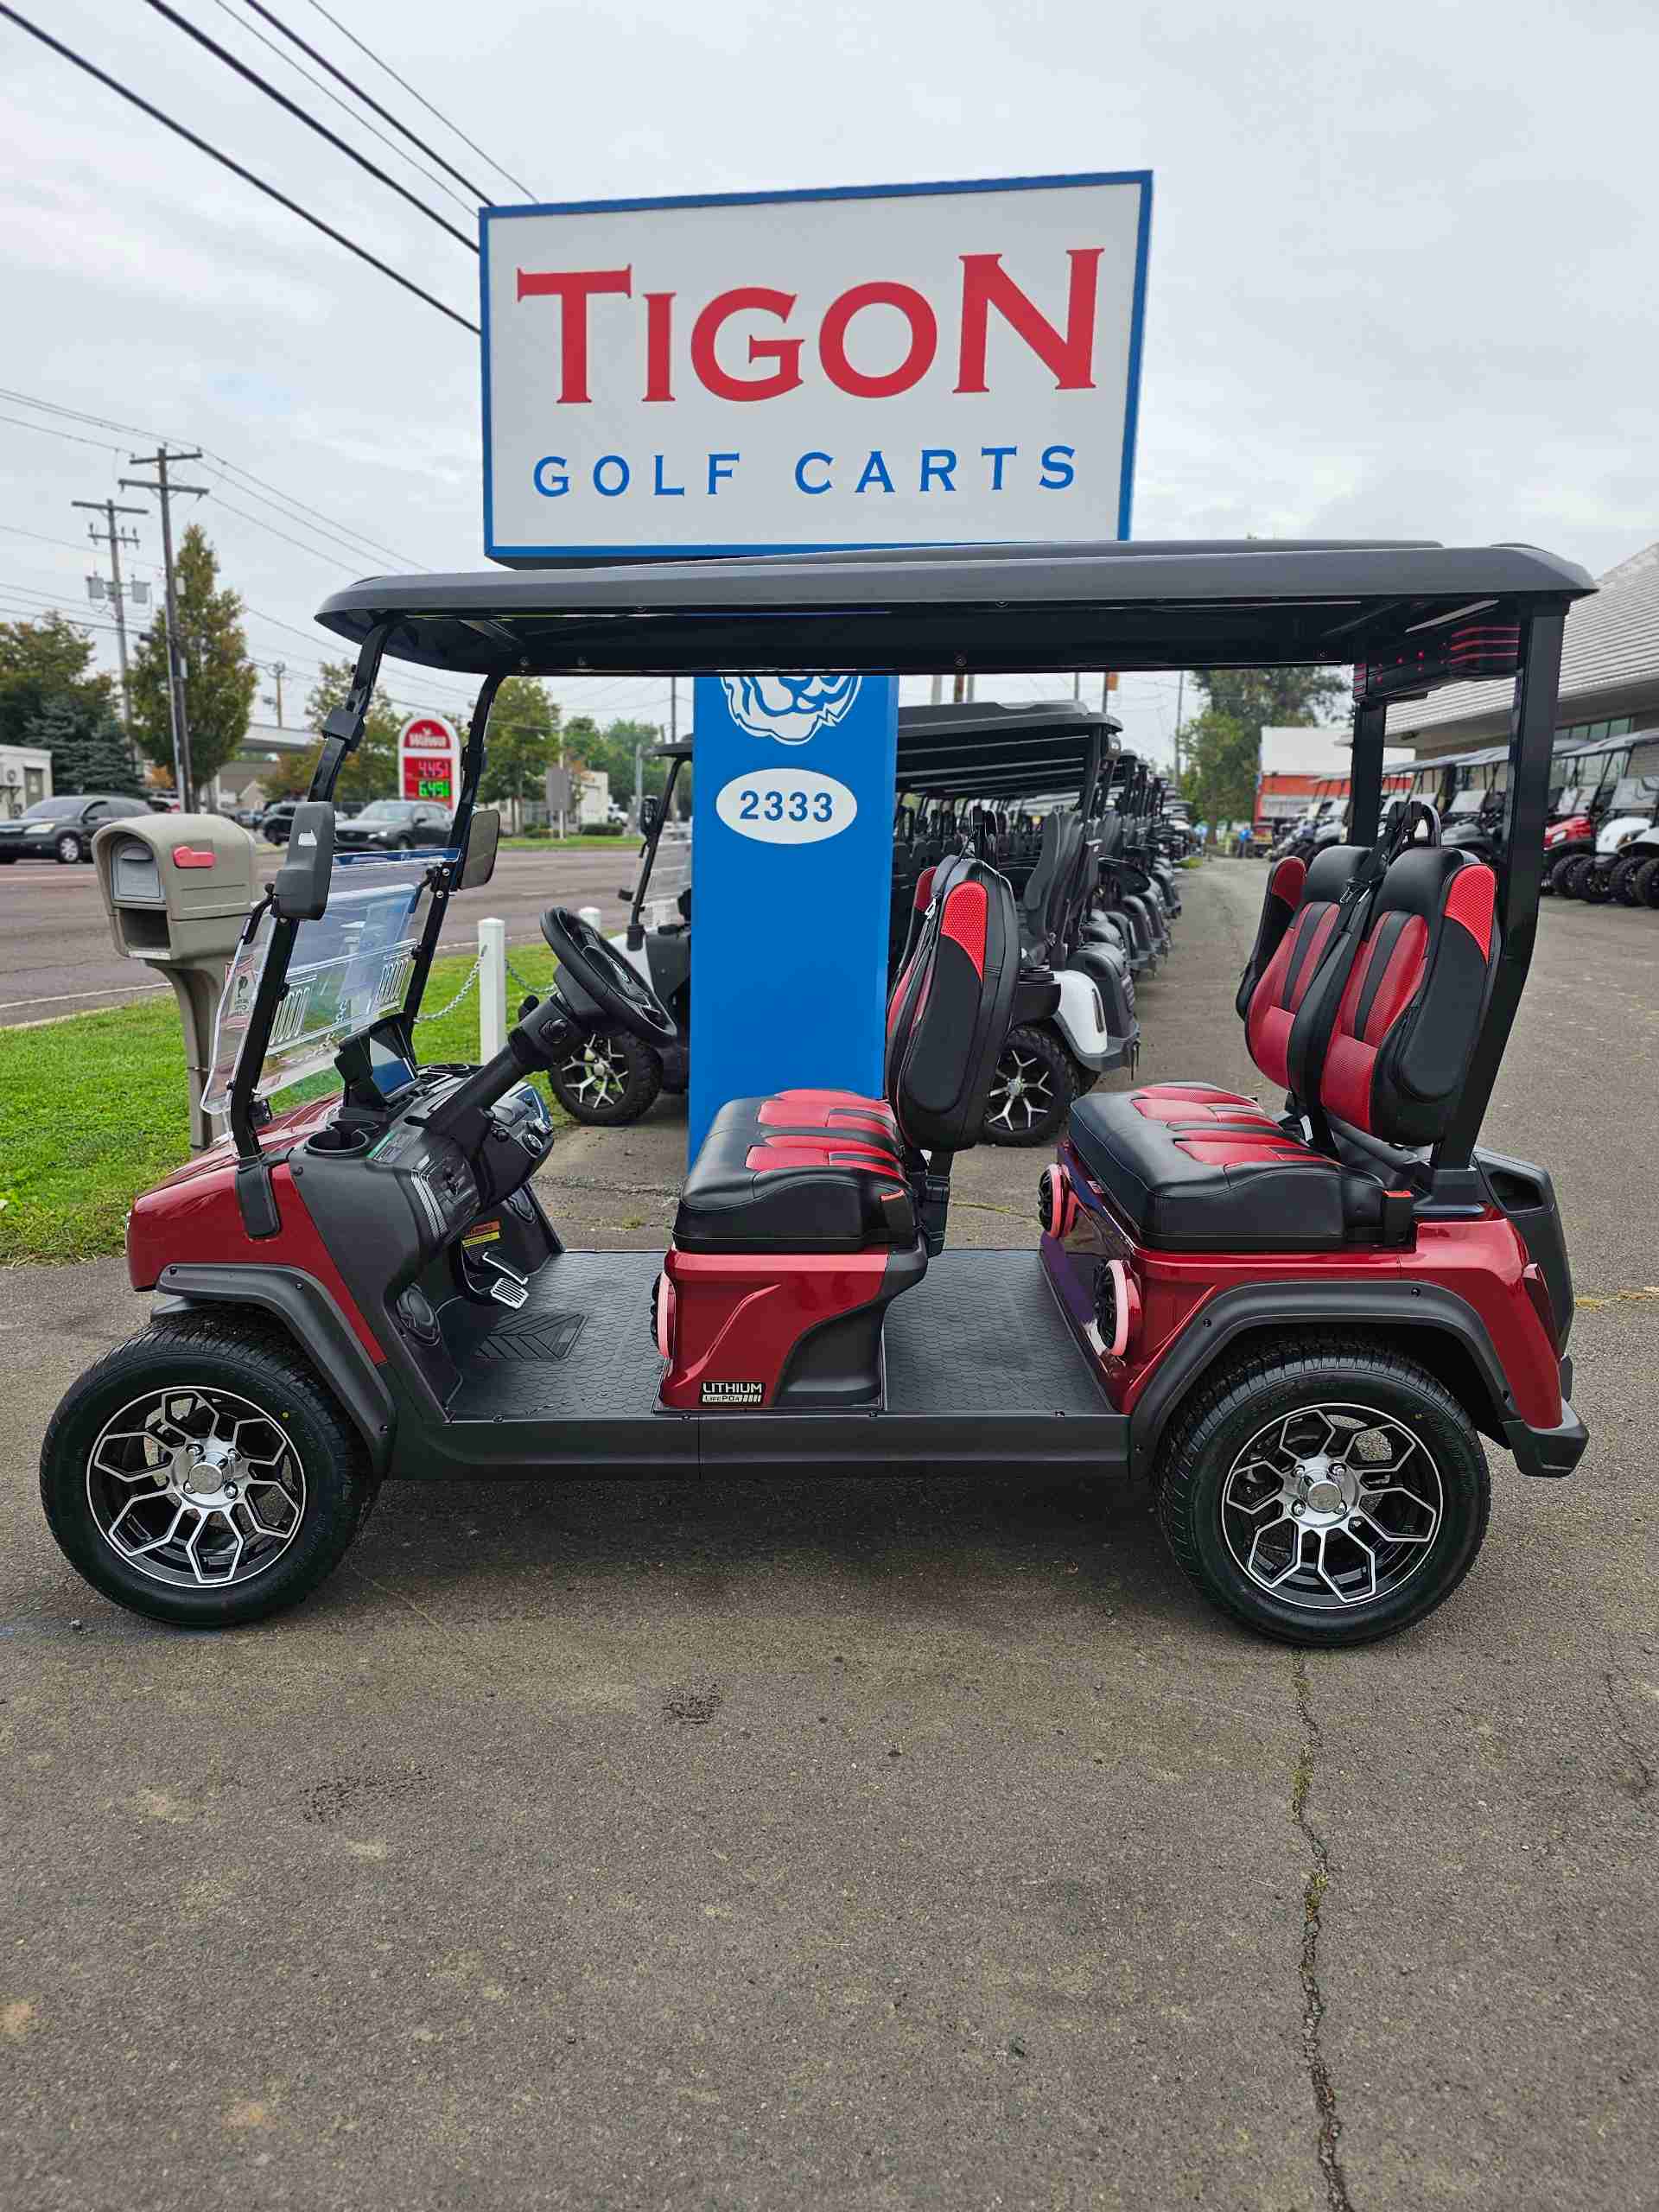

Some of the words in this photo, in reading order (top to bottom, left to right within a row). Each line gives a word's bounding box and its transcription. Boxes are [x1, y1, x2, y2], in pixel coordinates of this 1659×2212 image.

[517, 248, 1104, 404] TIGON
[532, 451, 741, 498] GOLF
[795, 444, 1077, 495] CARTS
[739, 790, 833, 823] 2333
[702, 1382, 762, 1393] LITHIUM
